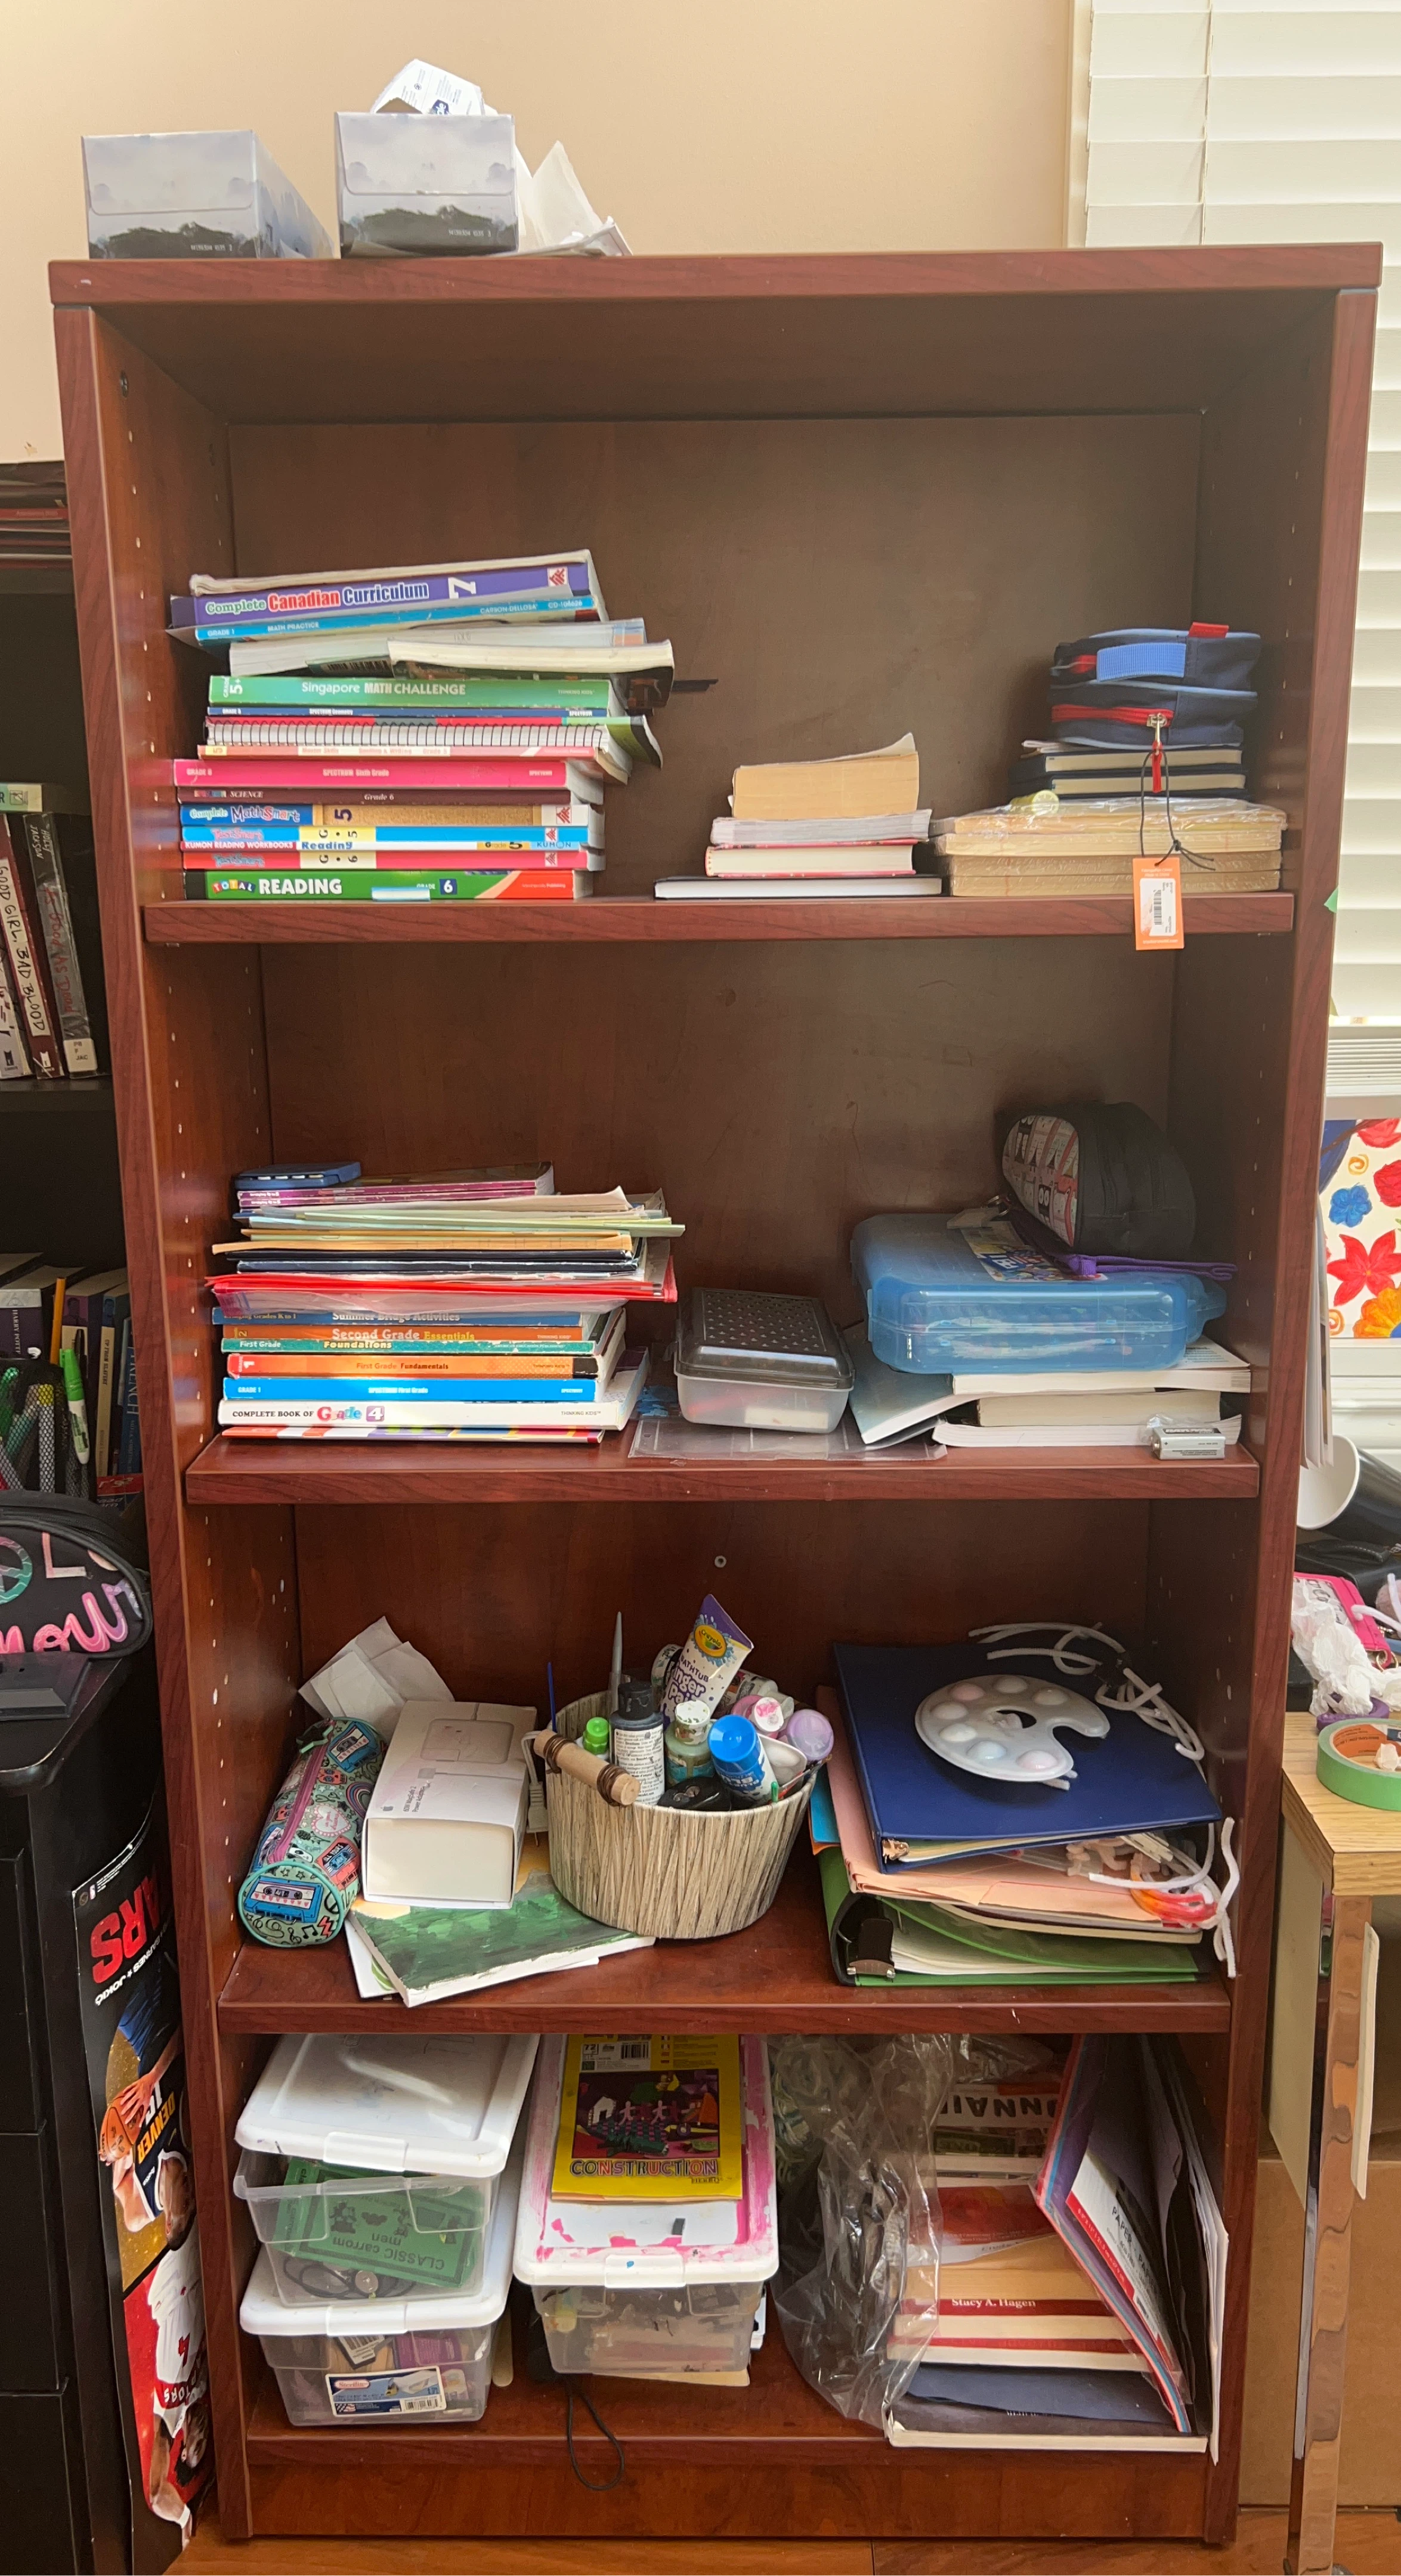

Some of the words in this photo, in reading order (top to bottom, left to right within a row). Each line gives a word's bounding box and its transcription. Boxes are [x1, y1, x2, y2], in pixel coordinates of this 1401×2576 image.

[205, 599, 266, 615] Complete
[268, 590, 341, 613] Canadian
[342, 581, 429, 604] Curriculum
[207, 628, 230, 637] GRADE
[268, 624, 286, 632] MATH
[286, 621, 320, 631] PRACTICE
[302, 682, 360, 695] Singapore
[364, 682, 392, 694] MATH
[394, 683, 466, 696] CHALLENGE
[230, 790, 264, 799] SCIENCE
[364, 792, 388, 801] Grade
[389, 792, 394, 801] 6
[190, 808, 228, 819] Complete
[231, 805, 301, 823] MathSmart
[185, 841, 213, 849] KUMON
[214, 841, 245, 849] READING
[301, 841, 353, 850] Reading
[212, 879, 256, 894] TOTAL
[258, 878, 342, 895] READING
[443, 880, 453, 893] 6
[16, 946, 32, 979] BAD
[22, 982, 45, 1032] BLOOD
[332, 1329, 380, 1340] Second
[382, 1329, 420, 1340] Grade
[423, 1330, 475, 1340] Essentials
[323, 1340, 392, 1349] Foundations
[317, 1406, 363, 1422] Grade
[367, 1407, 384, 1420] 4
[701, 1629, 722, 1648] Crayola
[672, 1661, 706, 1698] inger
[137, 2091, 176, 2165] DENVER
[570, 2159, 719, 2178] CONSTRUCTION
[332, 2236, 381, 2253] carrom
[371, 2233, 402, 2246] men
[384, 2248, 446, 2271] CLASSIC
[951, 2299, 982, 2308] Stacy
[998, 2299, 1037, 2309] Hagen
